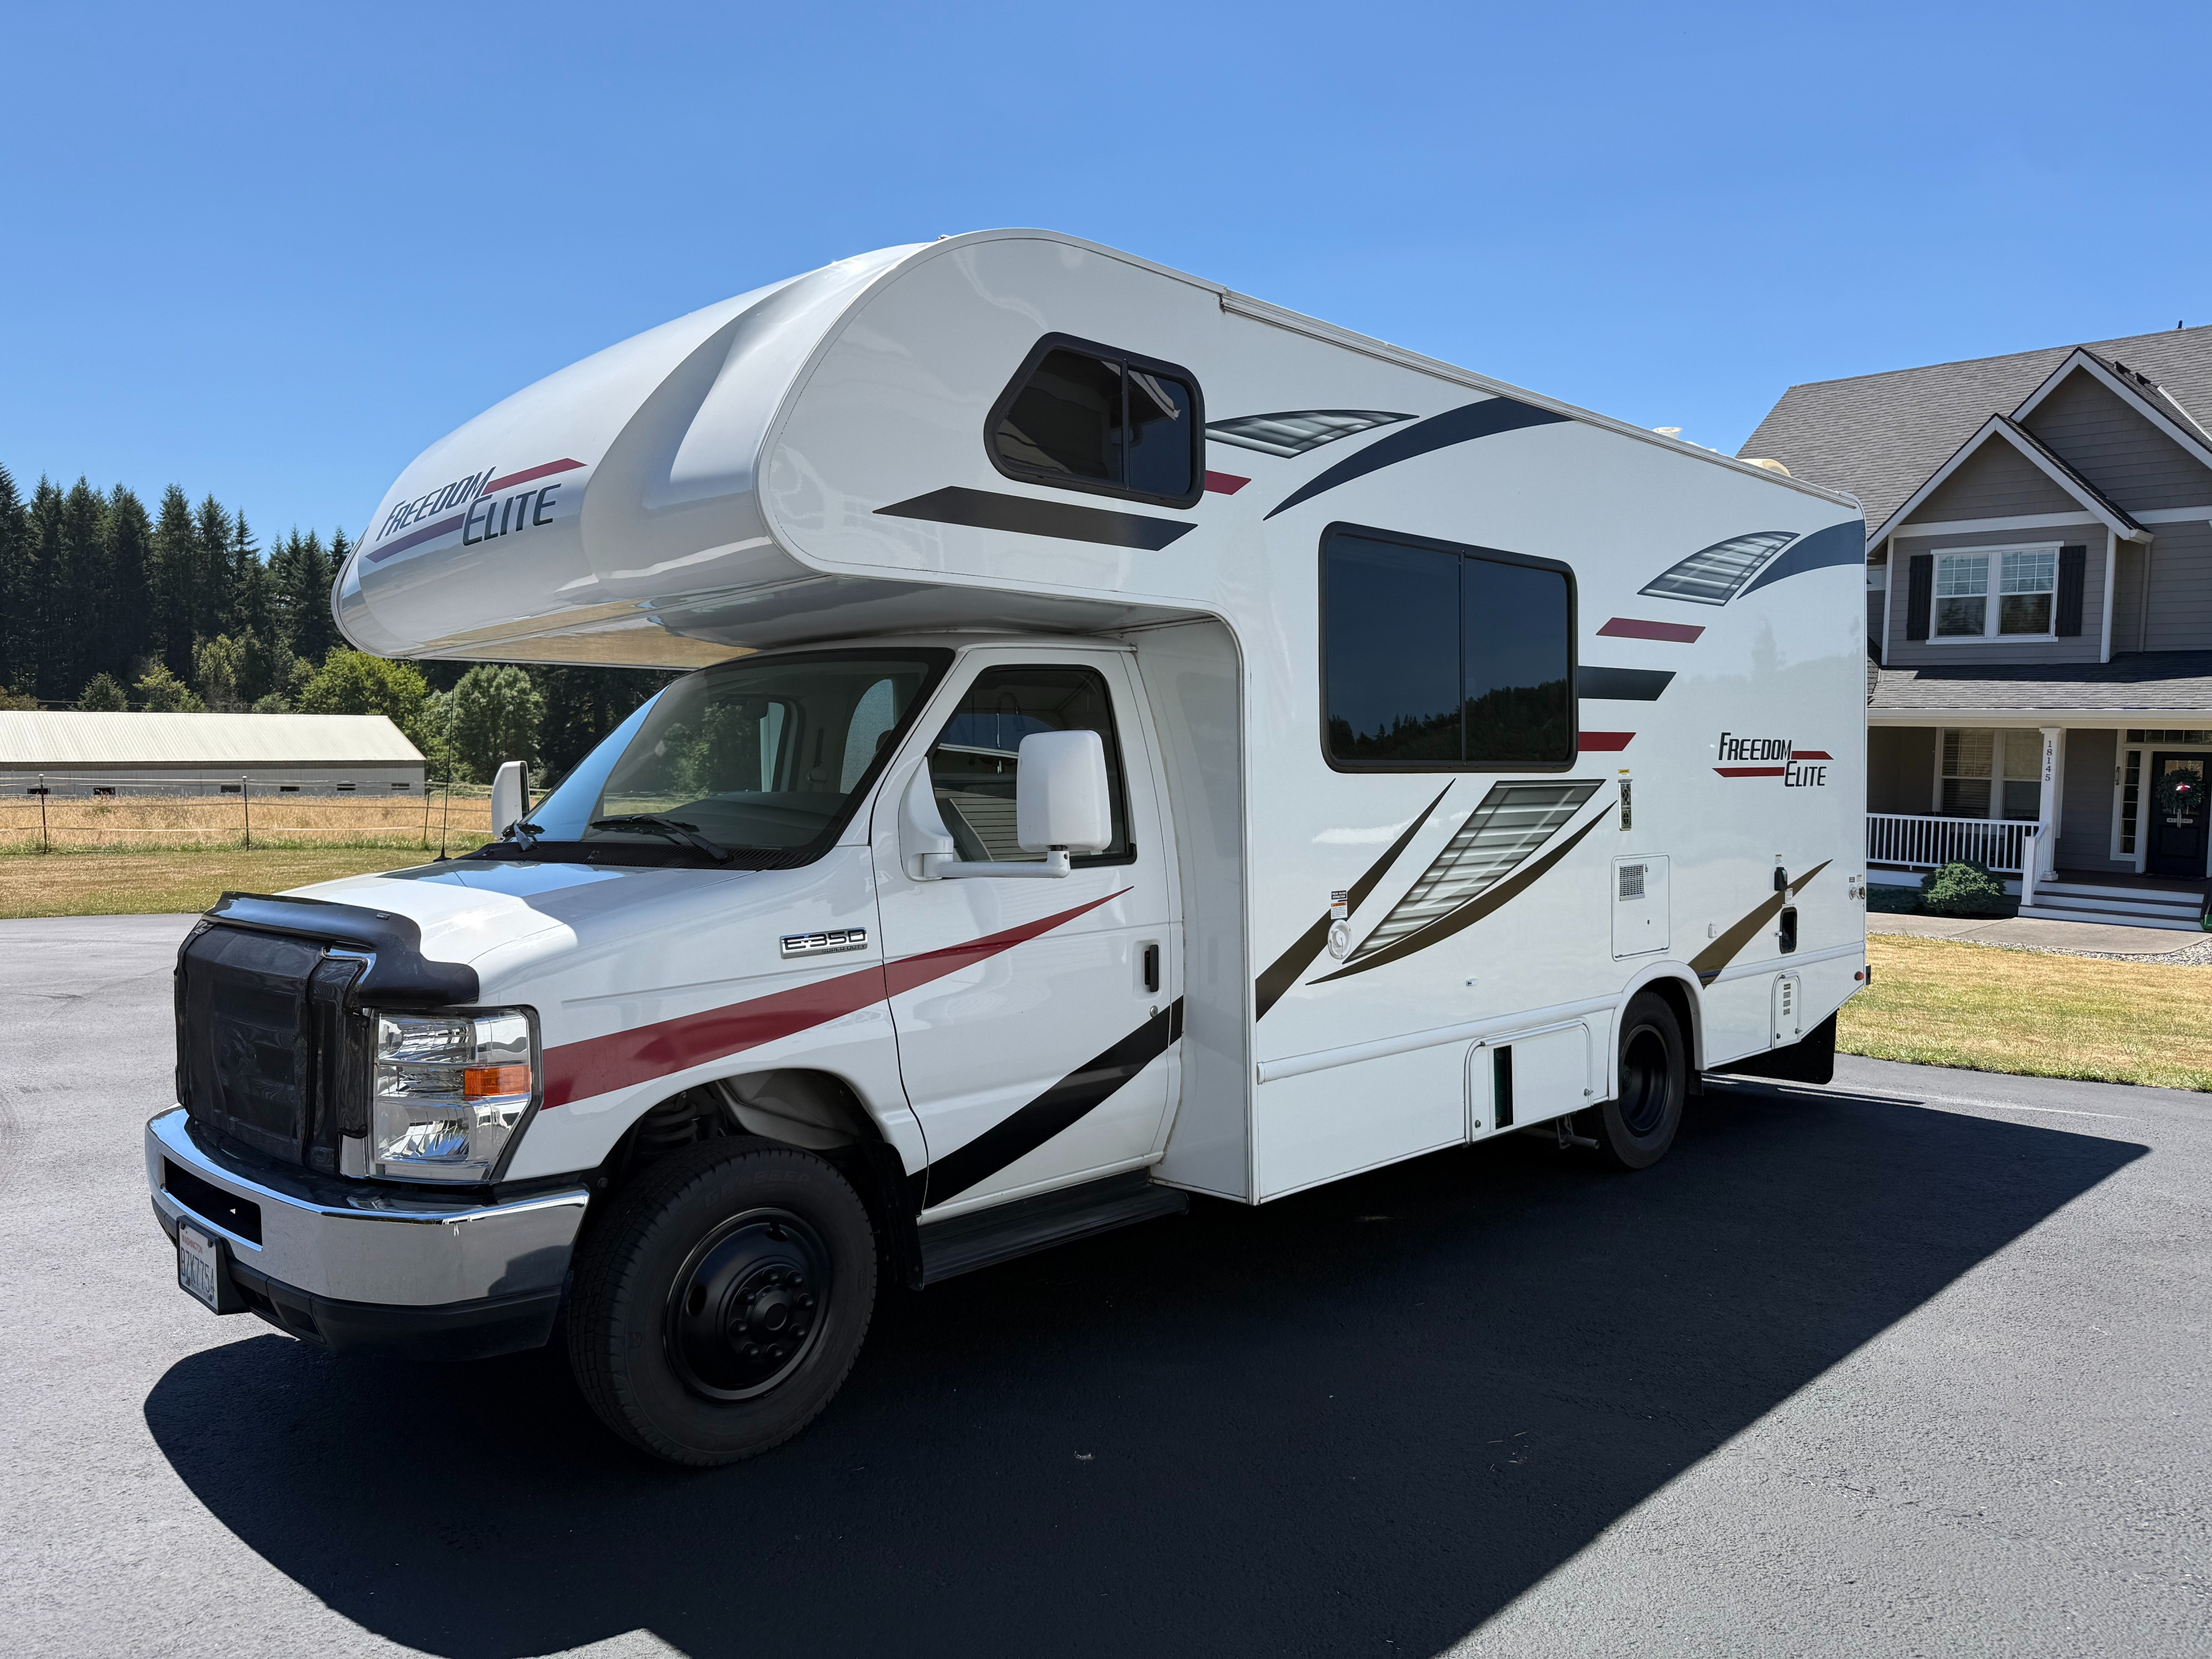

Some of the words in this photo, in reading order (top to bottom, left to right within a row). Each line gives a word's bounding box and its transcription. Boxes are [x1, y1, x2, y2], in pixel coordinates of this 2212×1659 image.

[375, 466, 497, 542] FREEDOM
[462, 483, 562, 546] ELITE
[1718, 732, 1792, 761] FREEDOM
[2044, 740, 2053, 781] 18145
[1784, 760, 1827, 787] ELITE
[783, 928, 867, 951] E-350
[704, 1168, 810, 1209] GRABBER
[181, 1234, 203, 1255] WASHINGTON
